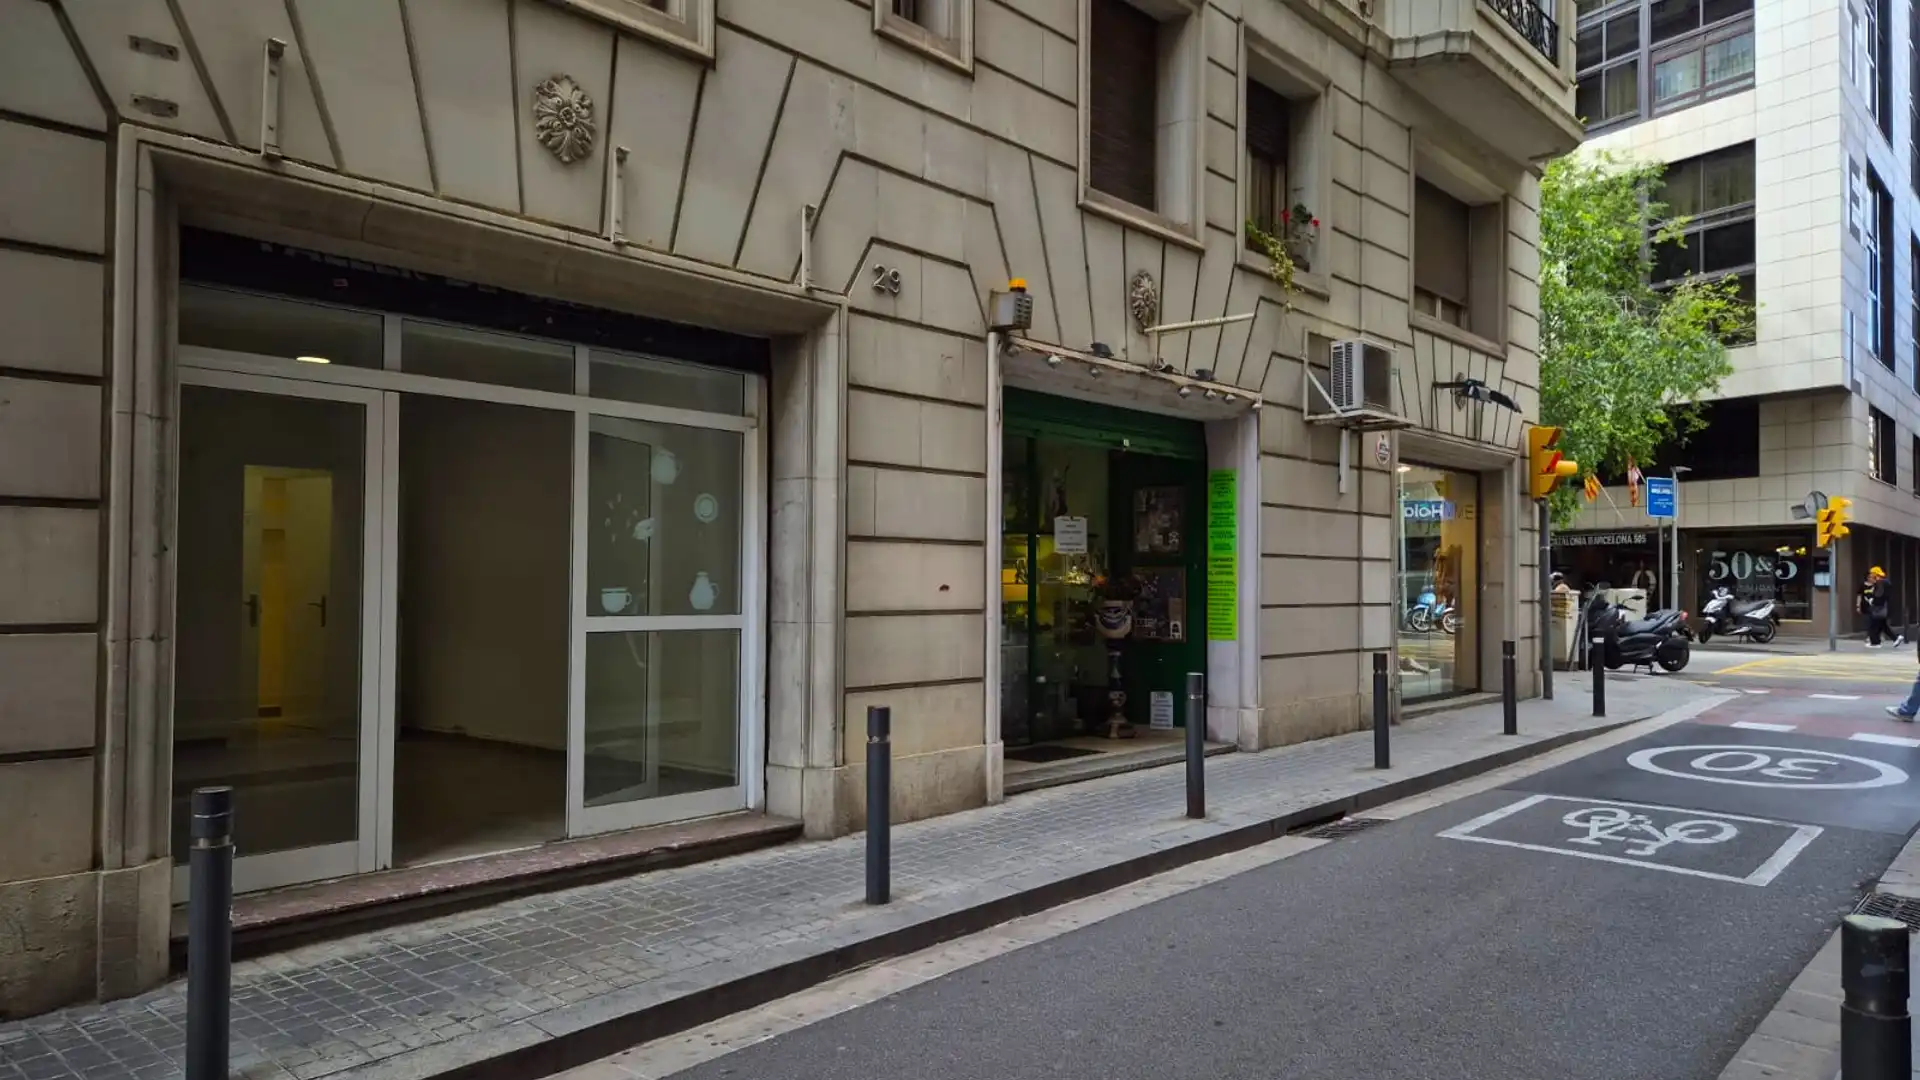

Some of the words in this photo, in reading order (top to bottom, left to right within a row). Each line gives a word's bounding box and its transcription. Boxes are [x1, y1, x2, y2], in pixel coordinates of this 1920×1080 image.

[872, 263, 901, 297] 29
[1588, 533, 1632, 545] BARCELONA
[1708, 550, 1798, 580] 50&5
[1689, 751, 1840, 780] 30
